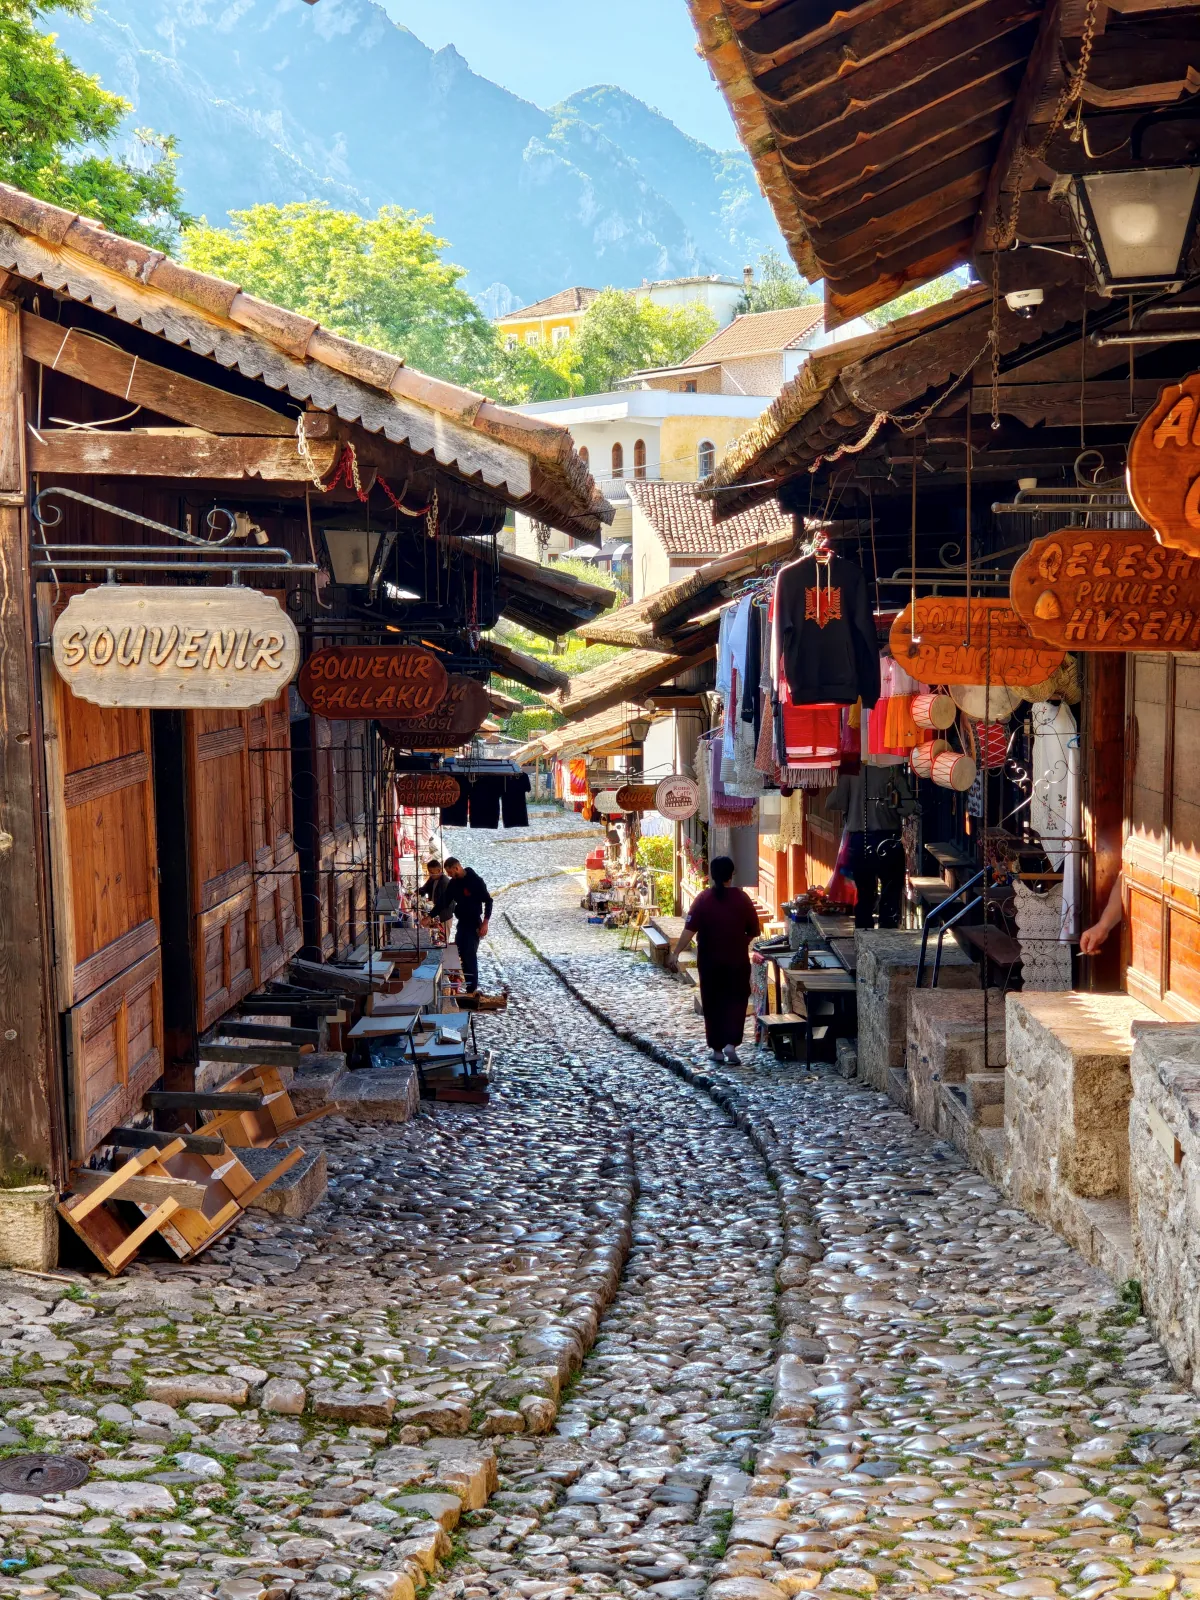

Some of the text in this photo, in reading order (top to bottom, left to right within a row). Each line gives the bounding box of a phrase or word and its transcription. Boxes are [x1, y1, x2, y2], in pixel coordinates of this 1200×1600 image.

[1038, 541, 1200, 582] QELESH
[1076, 581, 1178, 606] PUNUES
[61, 624, 285, 671] SOUVENIR
[309, 653, 433, 680] SOUVENIR
[311, 685, 434, 709] SALLAKU
[393, 734, 457, 747] SOUVENIR
